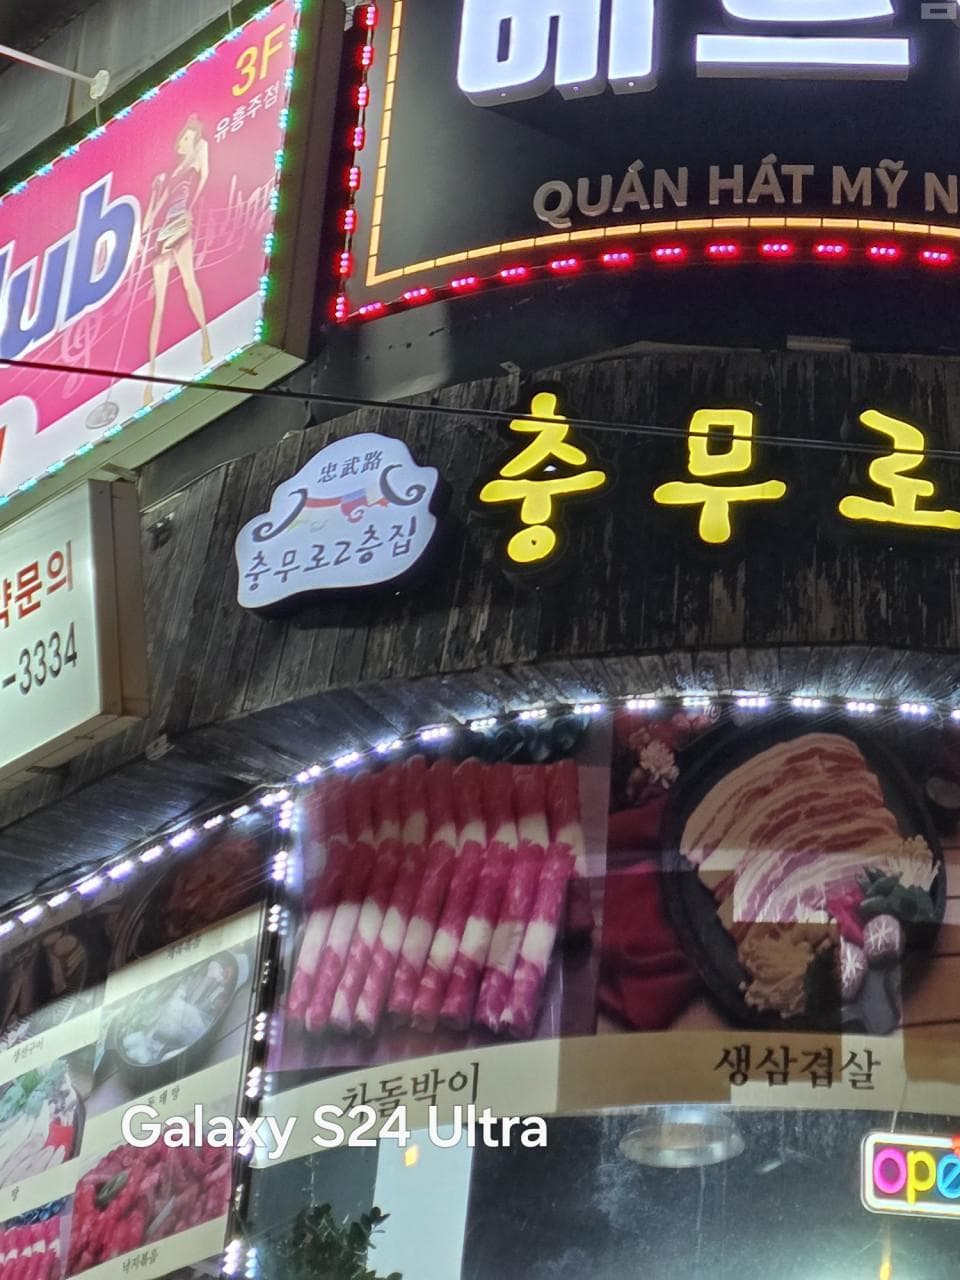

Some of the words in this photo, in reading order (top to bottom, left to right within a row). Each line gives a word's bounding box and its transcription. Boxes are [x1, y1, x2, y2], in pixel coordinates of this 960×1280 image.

[231, 24, 287, 98] 3F
[213, 80, 281, 144] 유흥주점
[533, 160, 690, 228] QUÁN
[707, 152, 815, 206] HÁT
[831, 156, 910, 208] MỸ
[317, 449, 384, 485] 忠武路
[243, 517, 417, 592] 충무로2층집
[340, 1061, 480, 1124] 차돌박이
[713, 1044, 881, 1090] 생삼겹살
